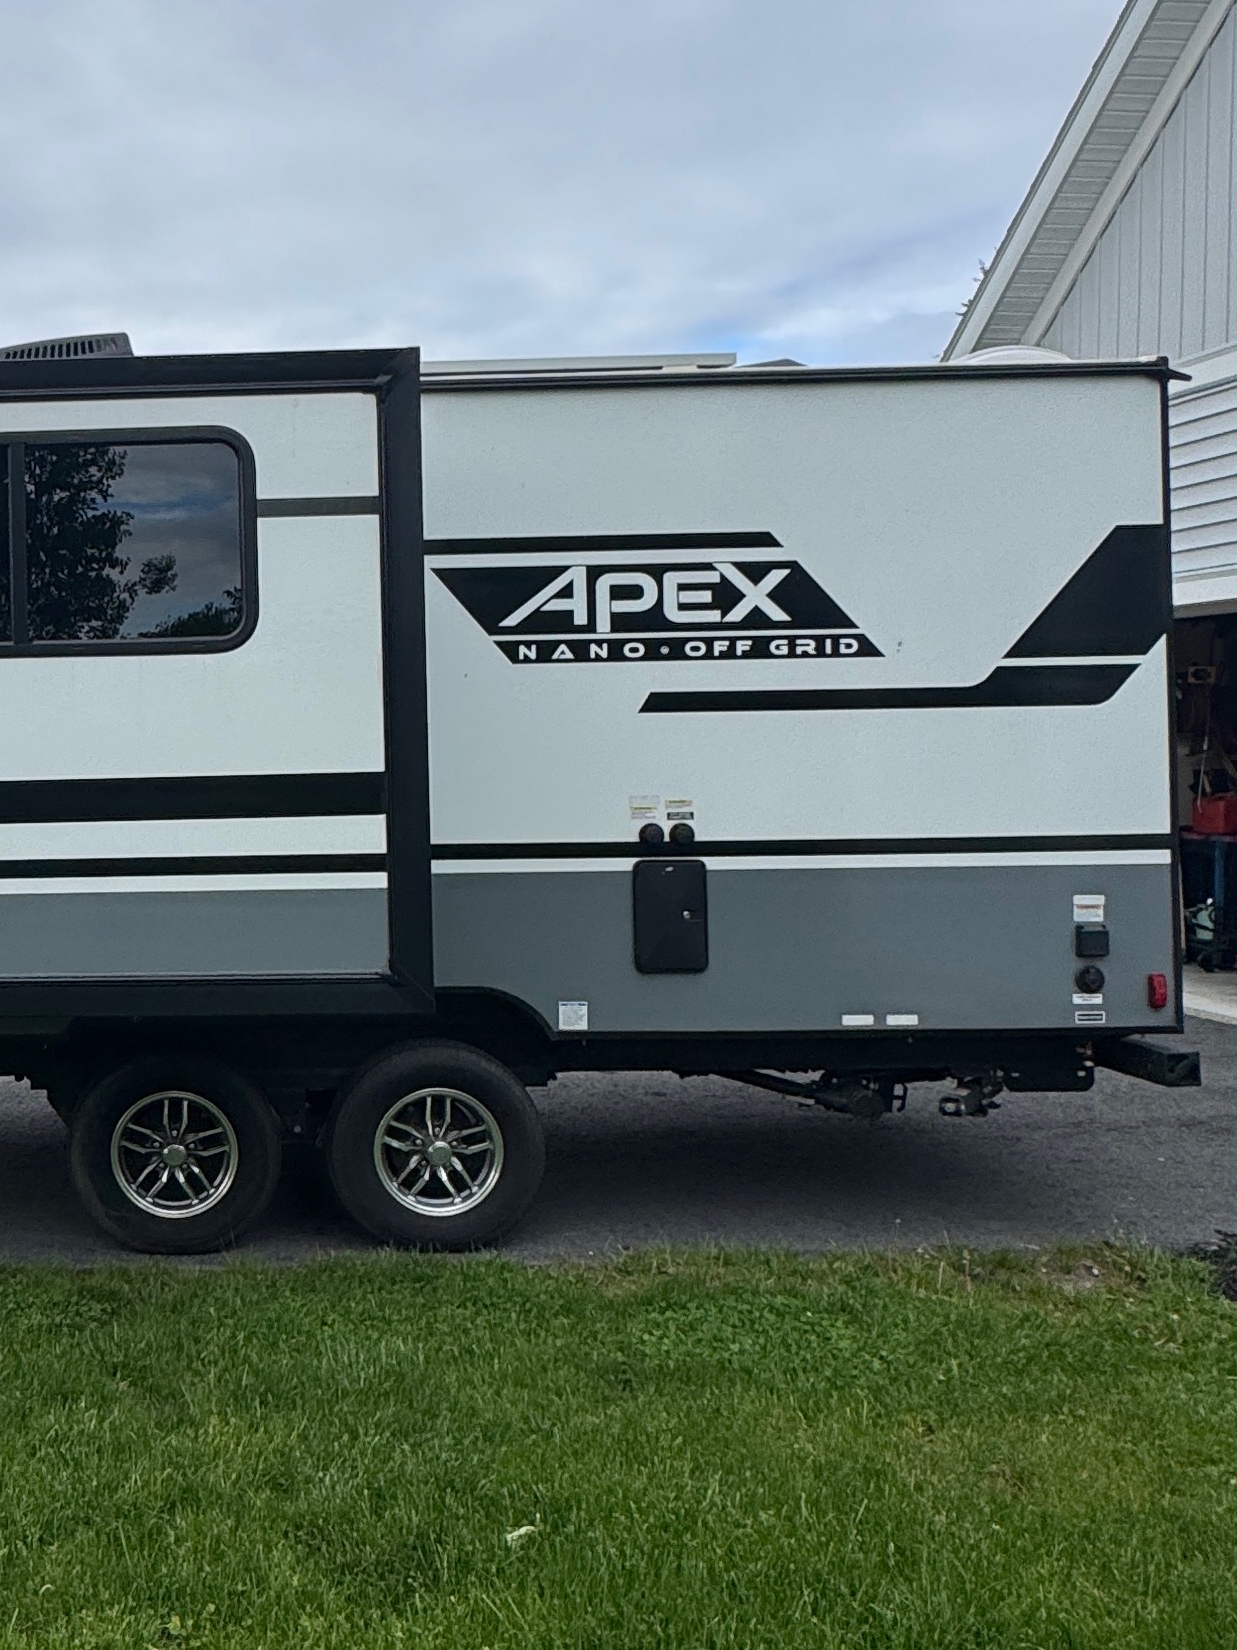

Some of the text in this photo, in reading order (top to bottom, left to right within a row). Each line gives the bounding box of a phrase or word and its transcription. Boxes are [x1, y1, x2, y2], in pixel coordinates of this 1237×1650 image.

[497, 562, 792, 633] APEX
[519, 637, 859, 661] NANO OFF GRID
